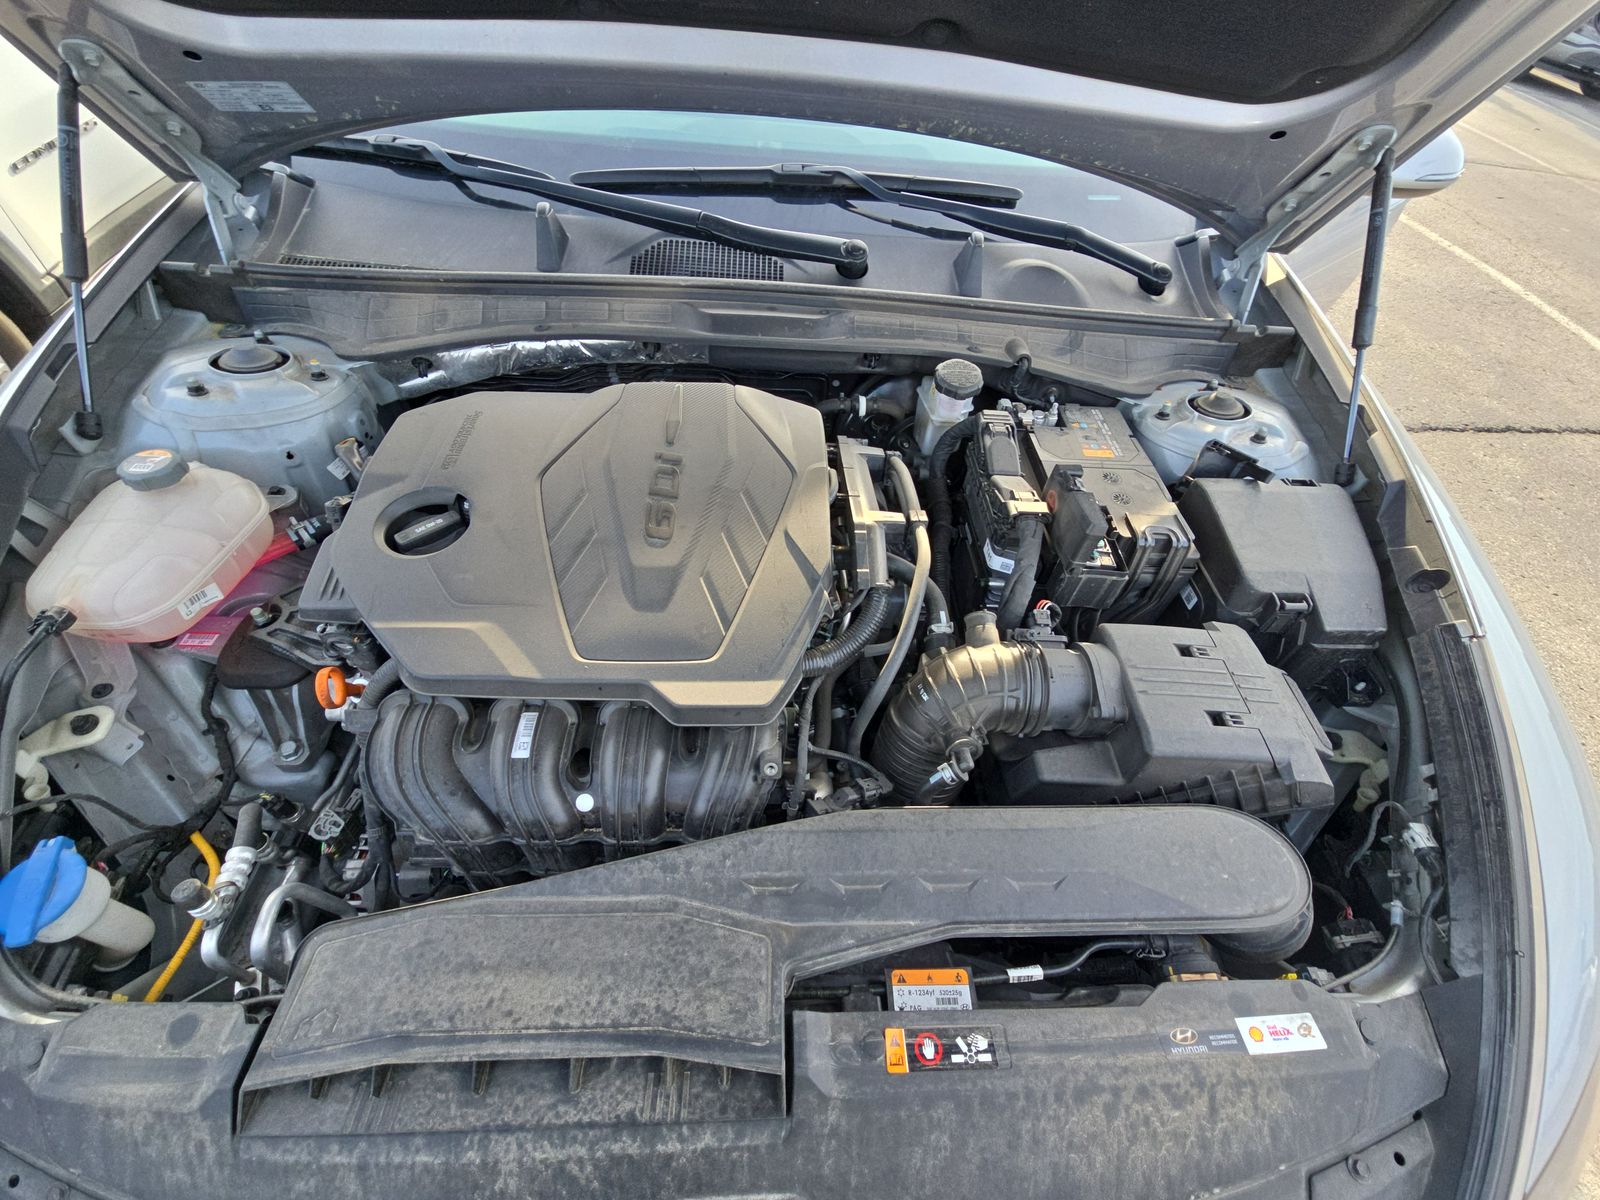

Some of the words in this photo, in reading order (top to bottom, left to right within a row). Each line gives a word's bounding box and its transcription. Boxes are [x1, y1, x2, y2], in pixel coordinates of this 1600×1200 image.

[907, 988, 935, 996] R-1234yf
[1268, 1029, 1290, 1037] HELIX
[1170, 1045, 1209, 1055] HYUNDAI
